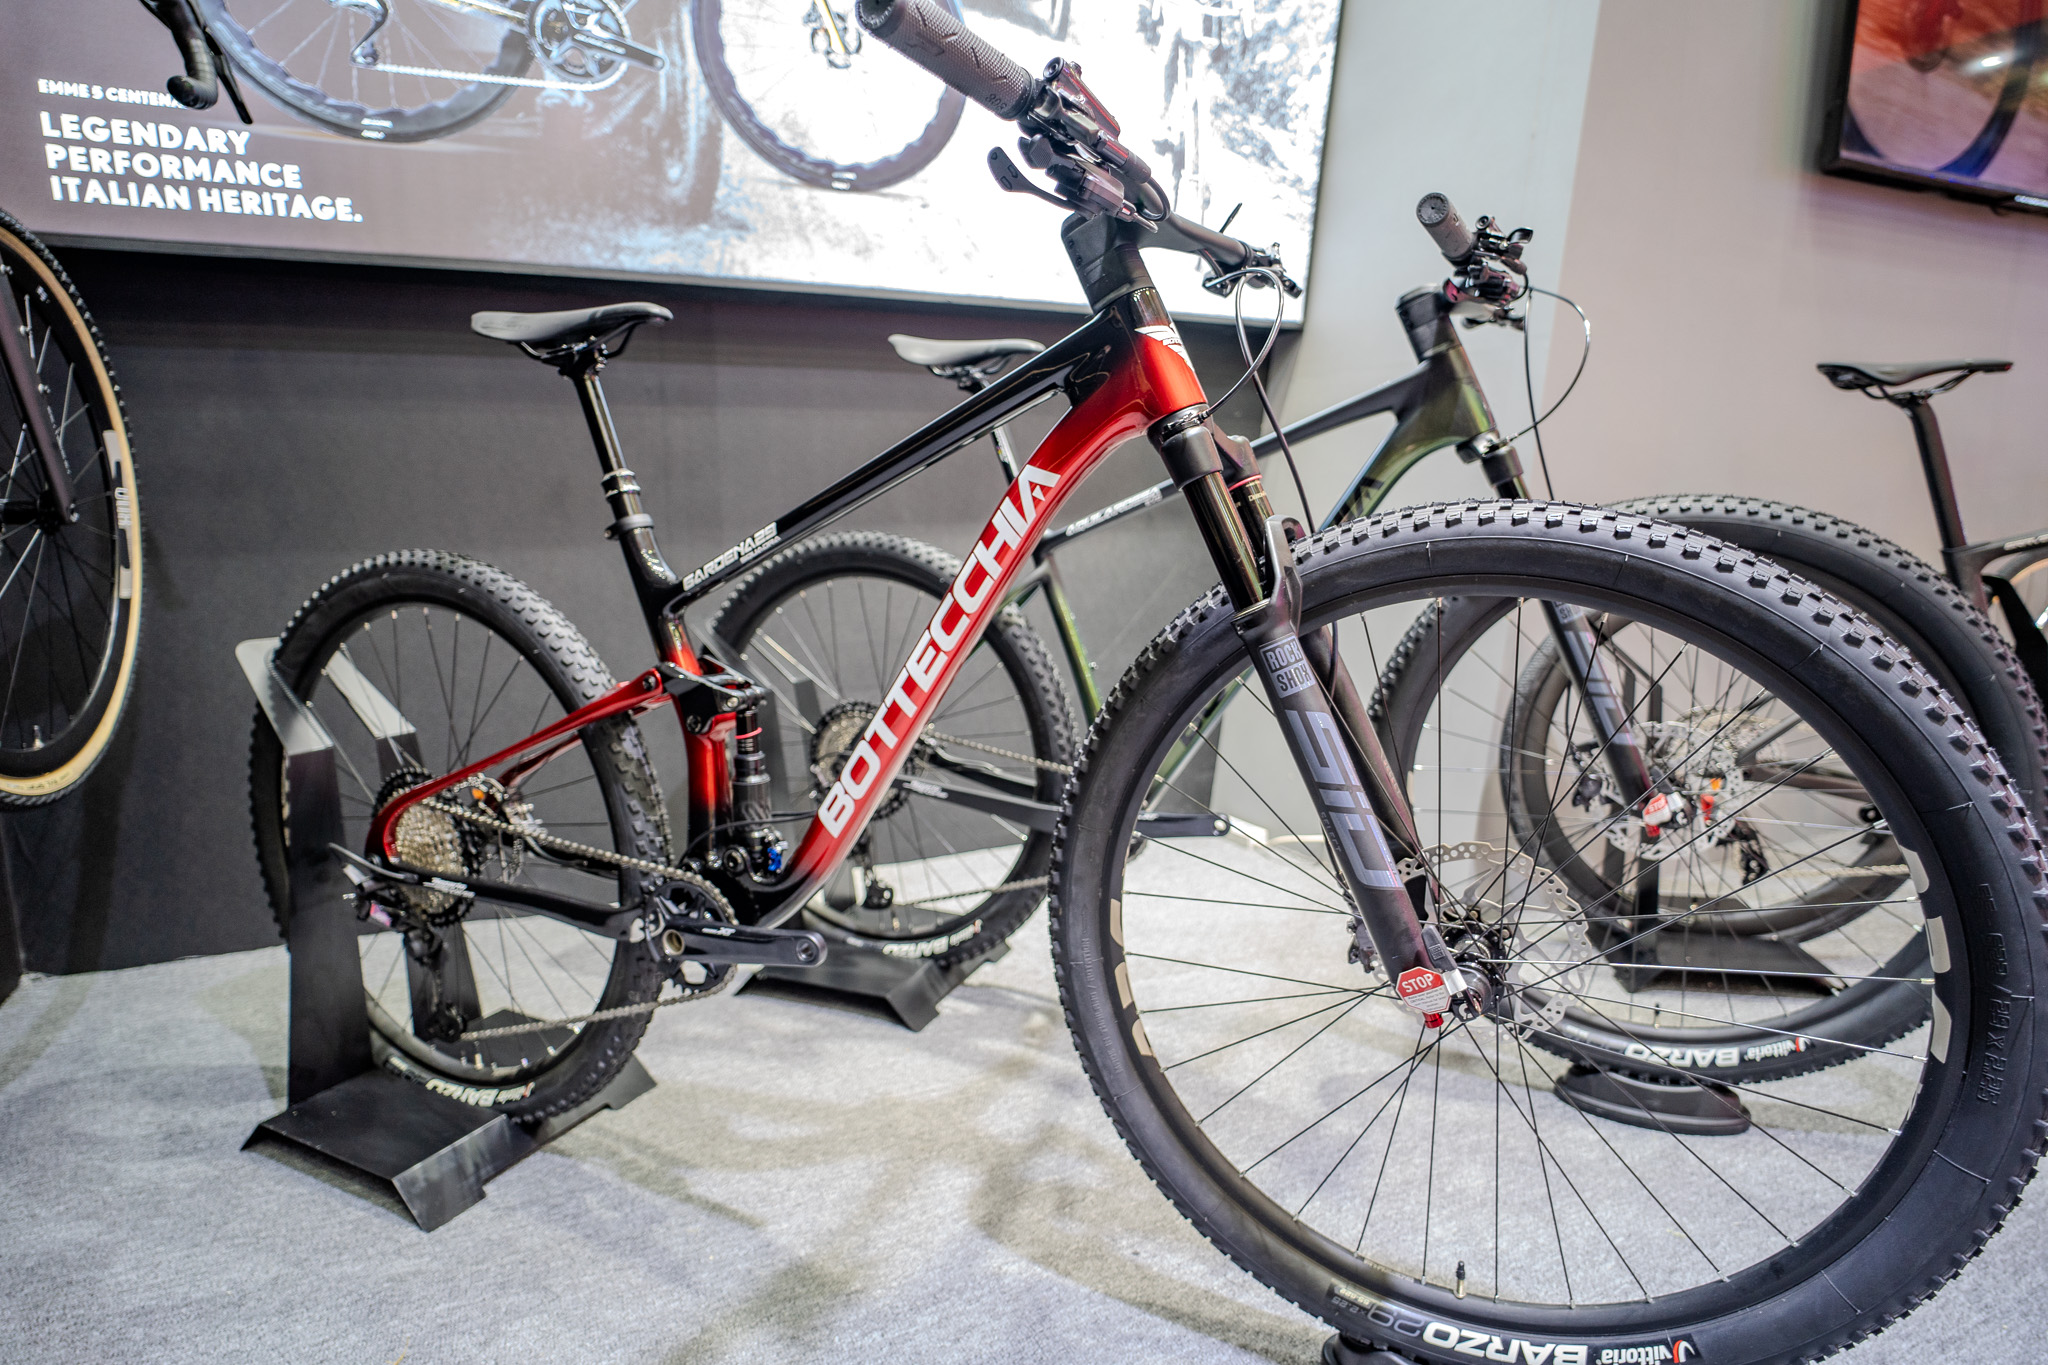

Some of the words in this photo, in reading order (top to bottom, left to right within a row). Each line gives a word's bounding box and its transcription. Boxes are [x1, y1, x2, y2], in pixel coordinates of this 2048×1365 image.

[38, 79, 90, 98] EMME
[91, 85, 104, 100] 5
[40, 111, 250, 155] LEGENDARY
[45, 143, 303, 189] PERFORMANCE
[50, 175, 192, 211] ITALIAN
[198, 187, 363, 223] HERITAGE.
[817, 464, 1061, 839] BOTTECCHIA
[1266, 642, 1303, 671] ROCK
[1276, 663, 1312, 693] SHOX
[1401, 973, 1434, 993] STOP
[1624, 1042, 1740, 1068] BARZO
[1422, 1320, 1590, 1365] BARZO
[1600, 1343, 1674, 1365] vittoria
